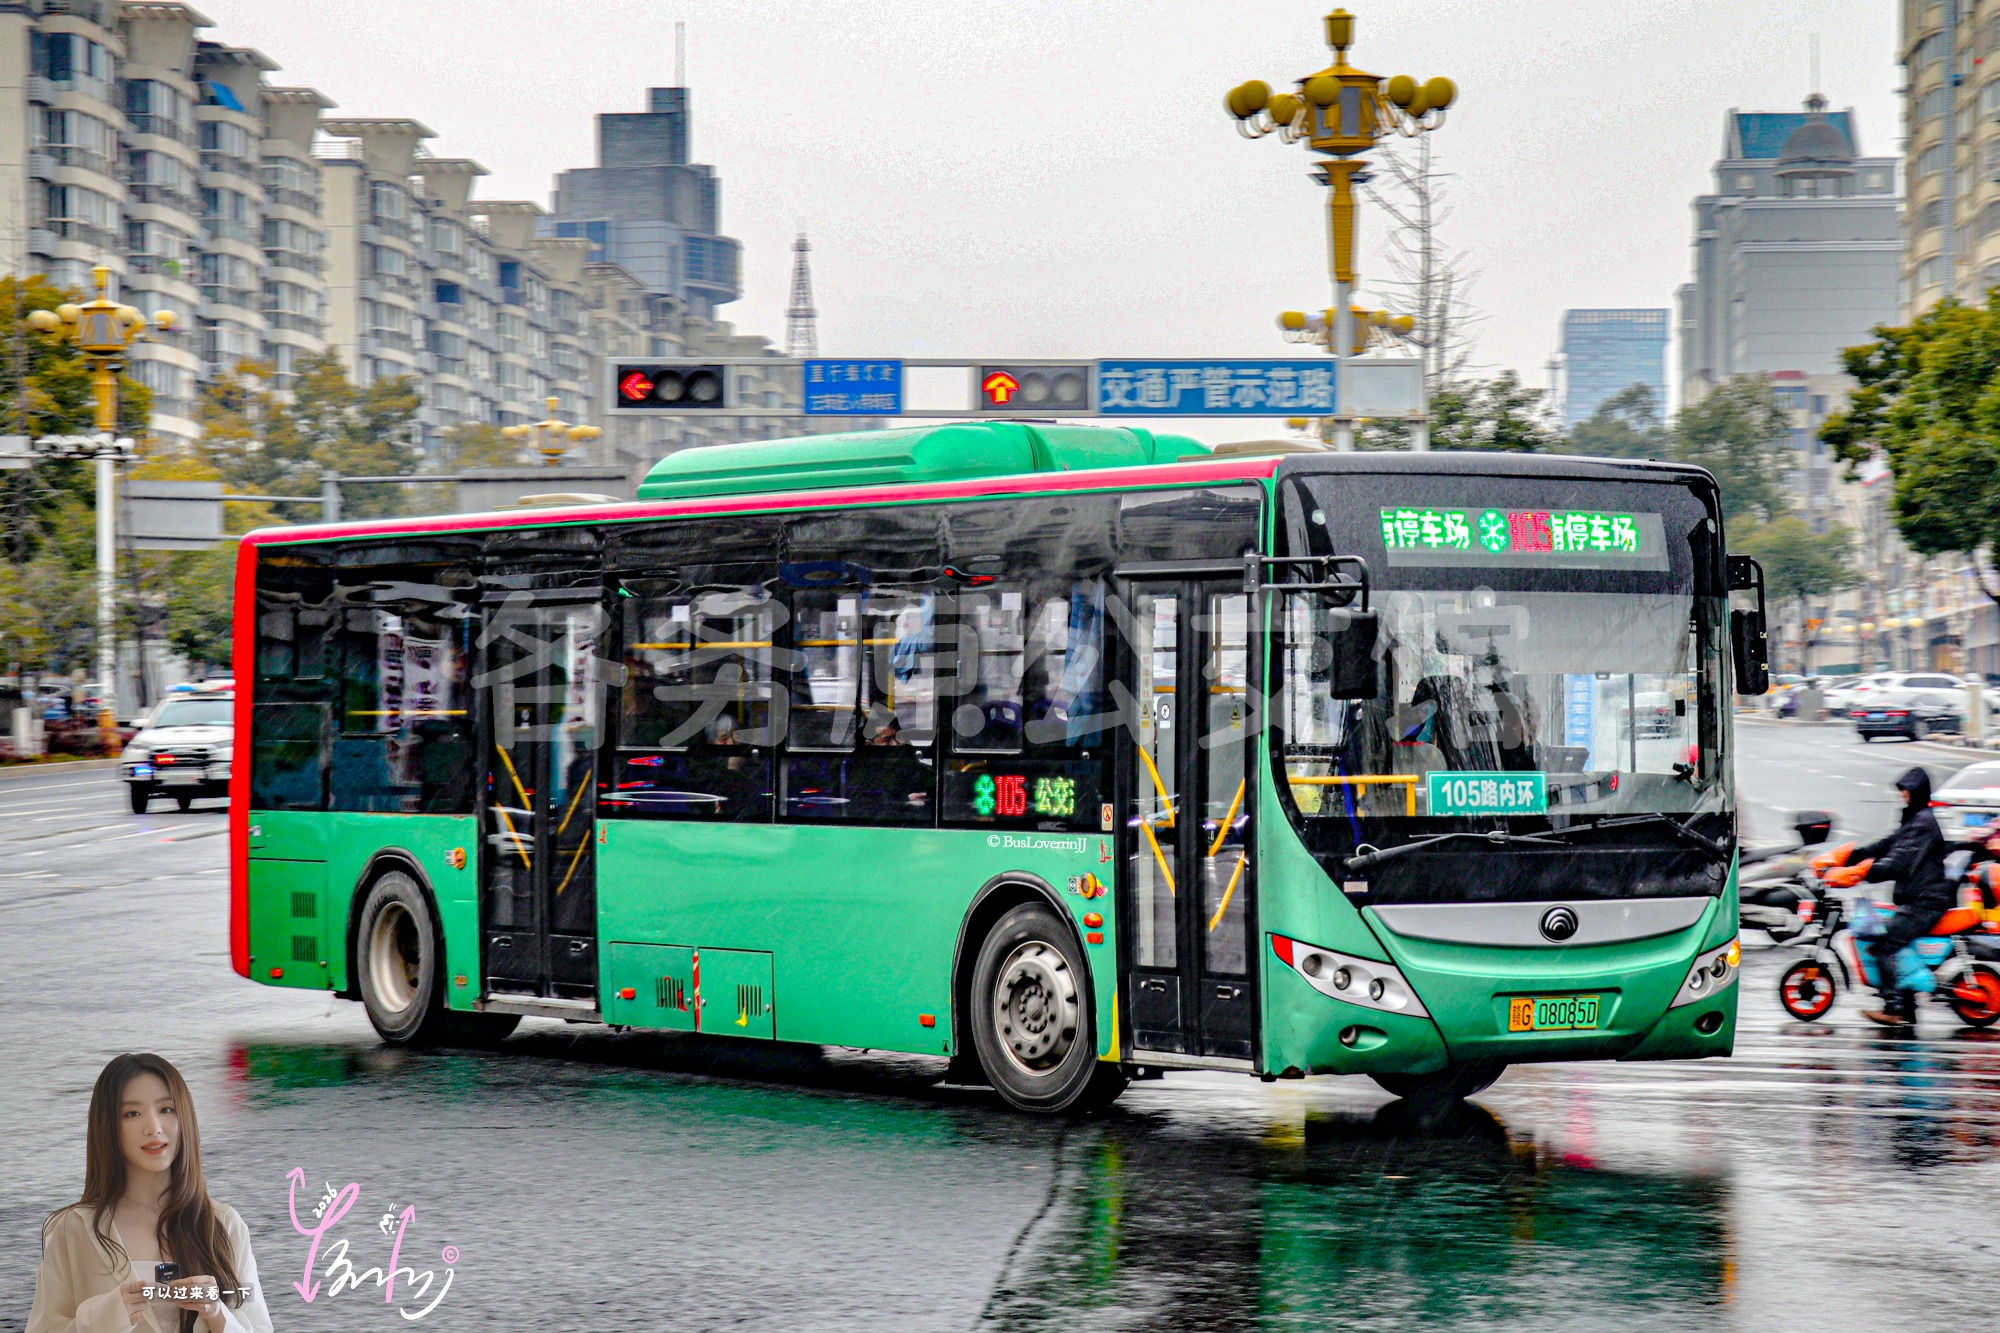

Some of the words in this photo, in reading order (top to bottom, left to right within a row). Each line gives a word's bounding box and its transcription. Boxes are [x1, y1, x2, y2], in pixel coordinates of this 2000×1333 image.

[1101, 366, 1334, 409] 交通严管示范路
[1508, 511, 1552, 553] 105
[995, 776, 1026, 815] 105
[1441, 779, 1534, 807] 105路内环
